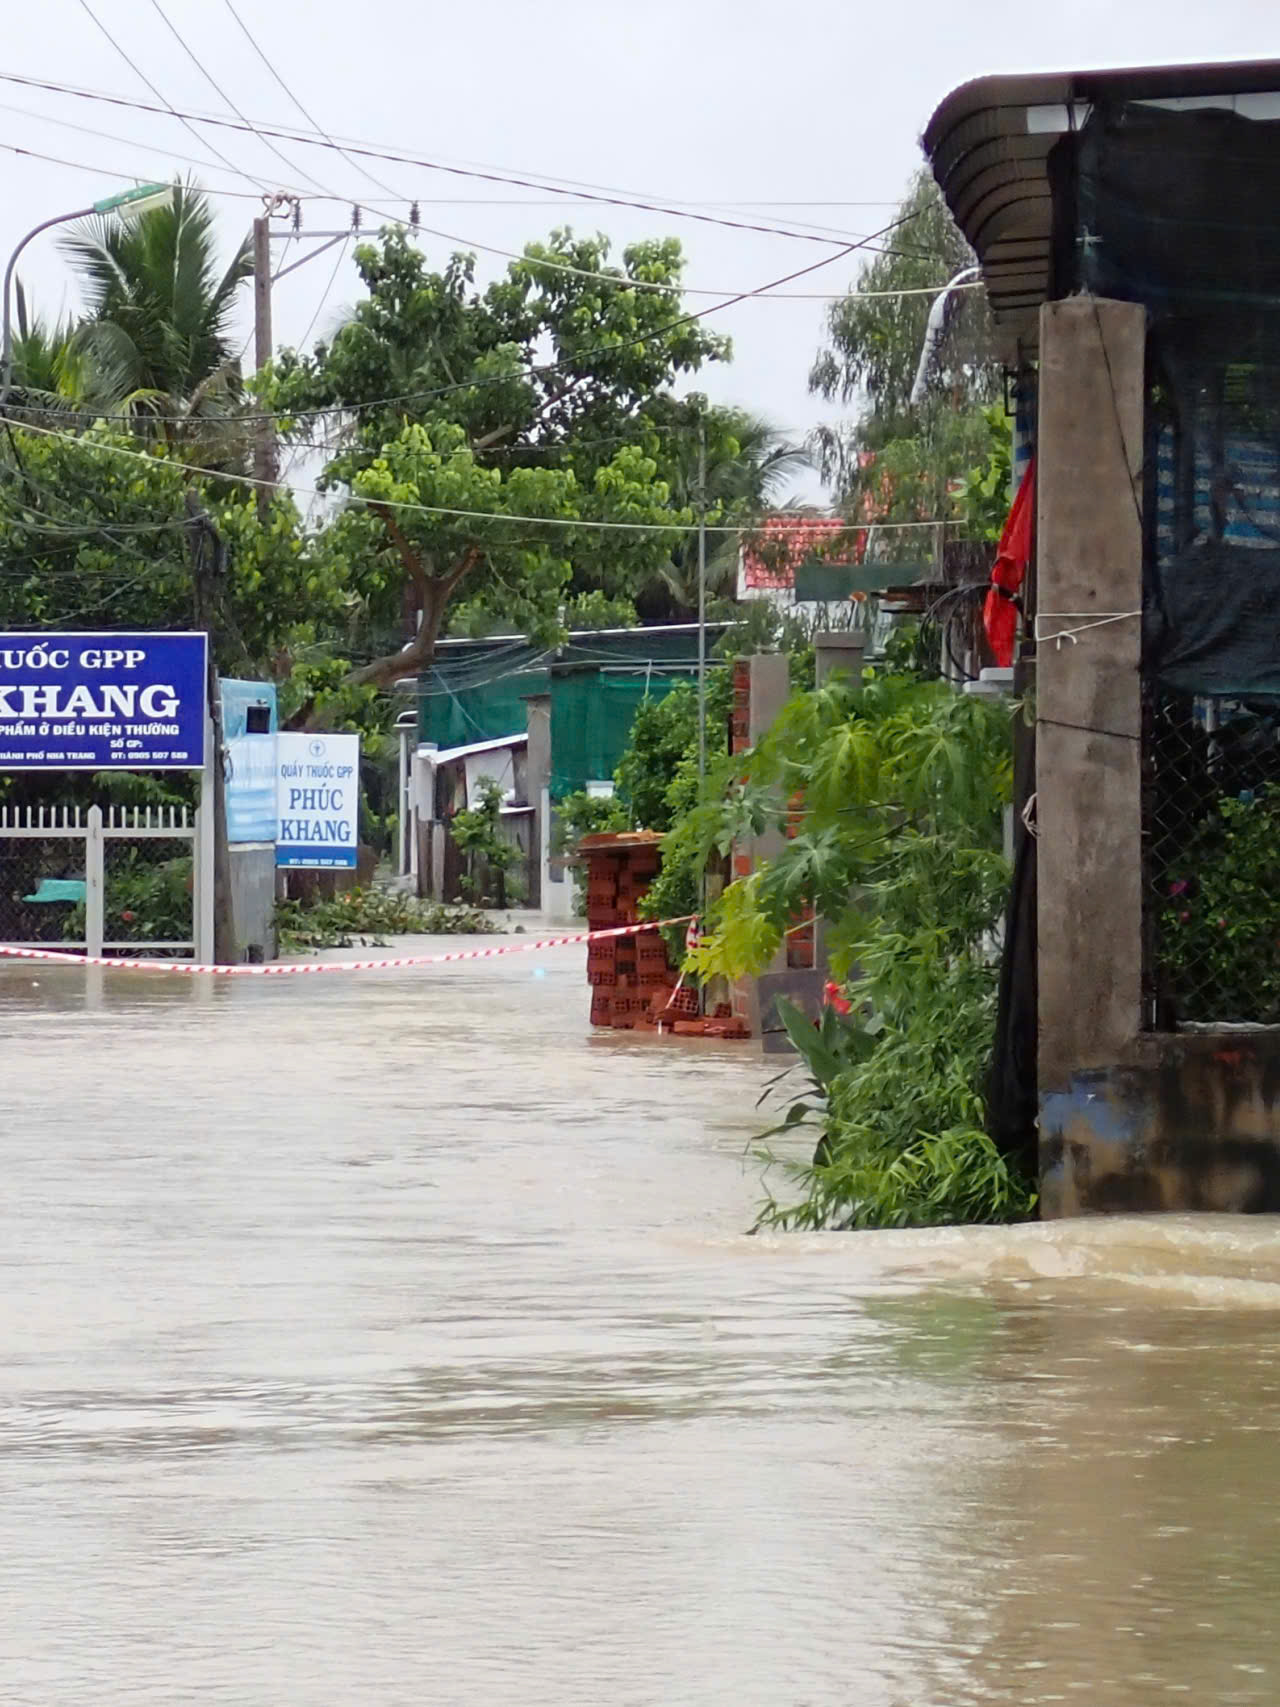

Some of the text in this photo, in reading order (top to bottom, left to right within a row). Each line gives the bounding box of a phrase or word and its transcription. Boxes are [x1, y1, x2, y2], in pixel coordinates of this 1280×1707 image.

[79, 649, 147, 669] GPP
[289, 782, 344, 811] PHÚC
[280, 819, 351, 842] KHANG
